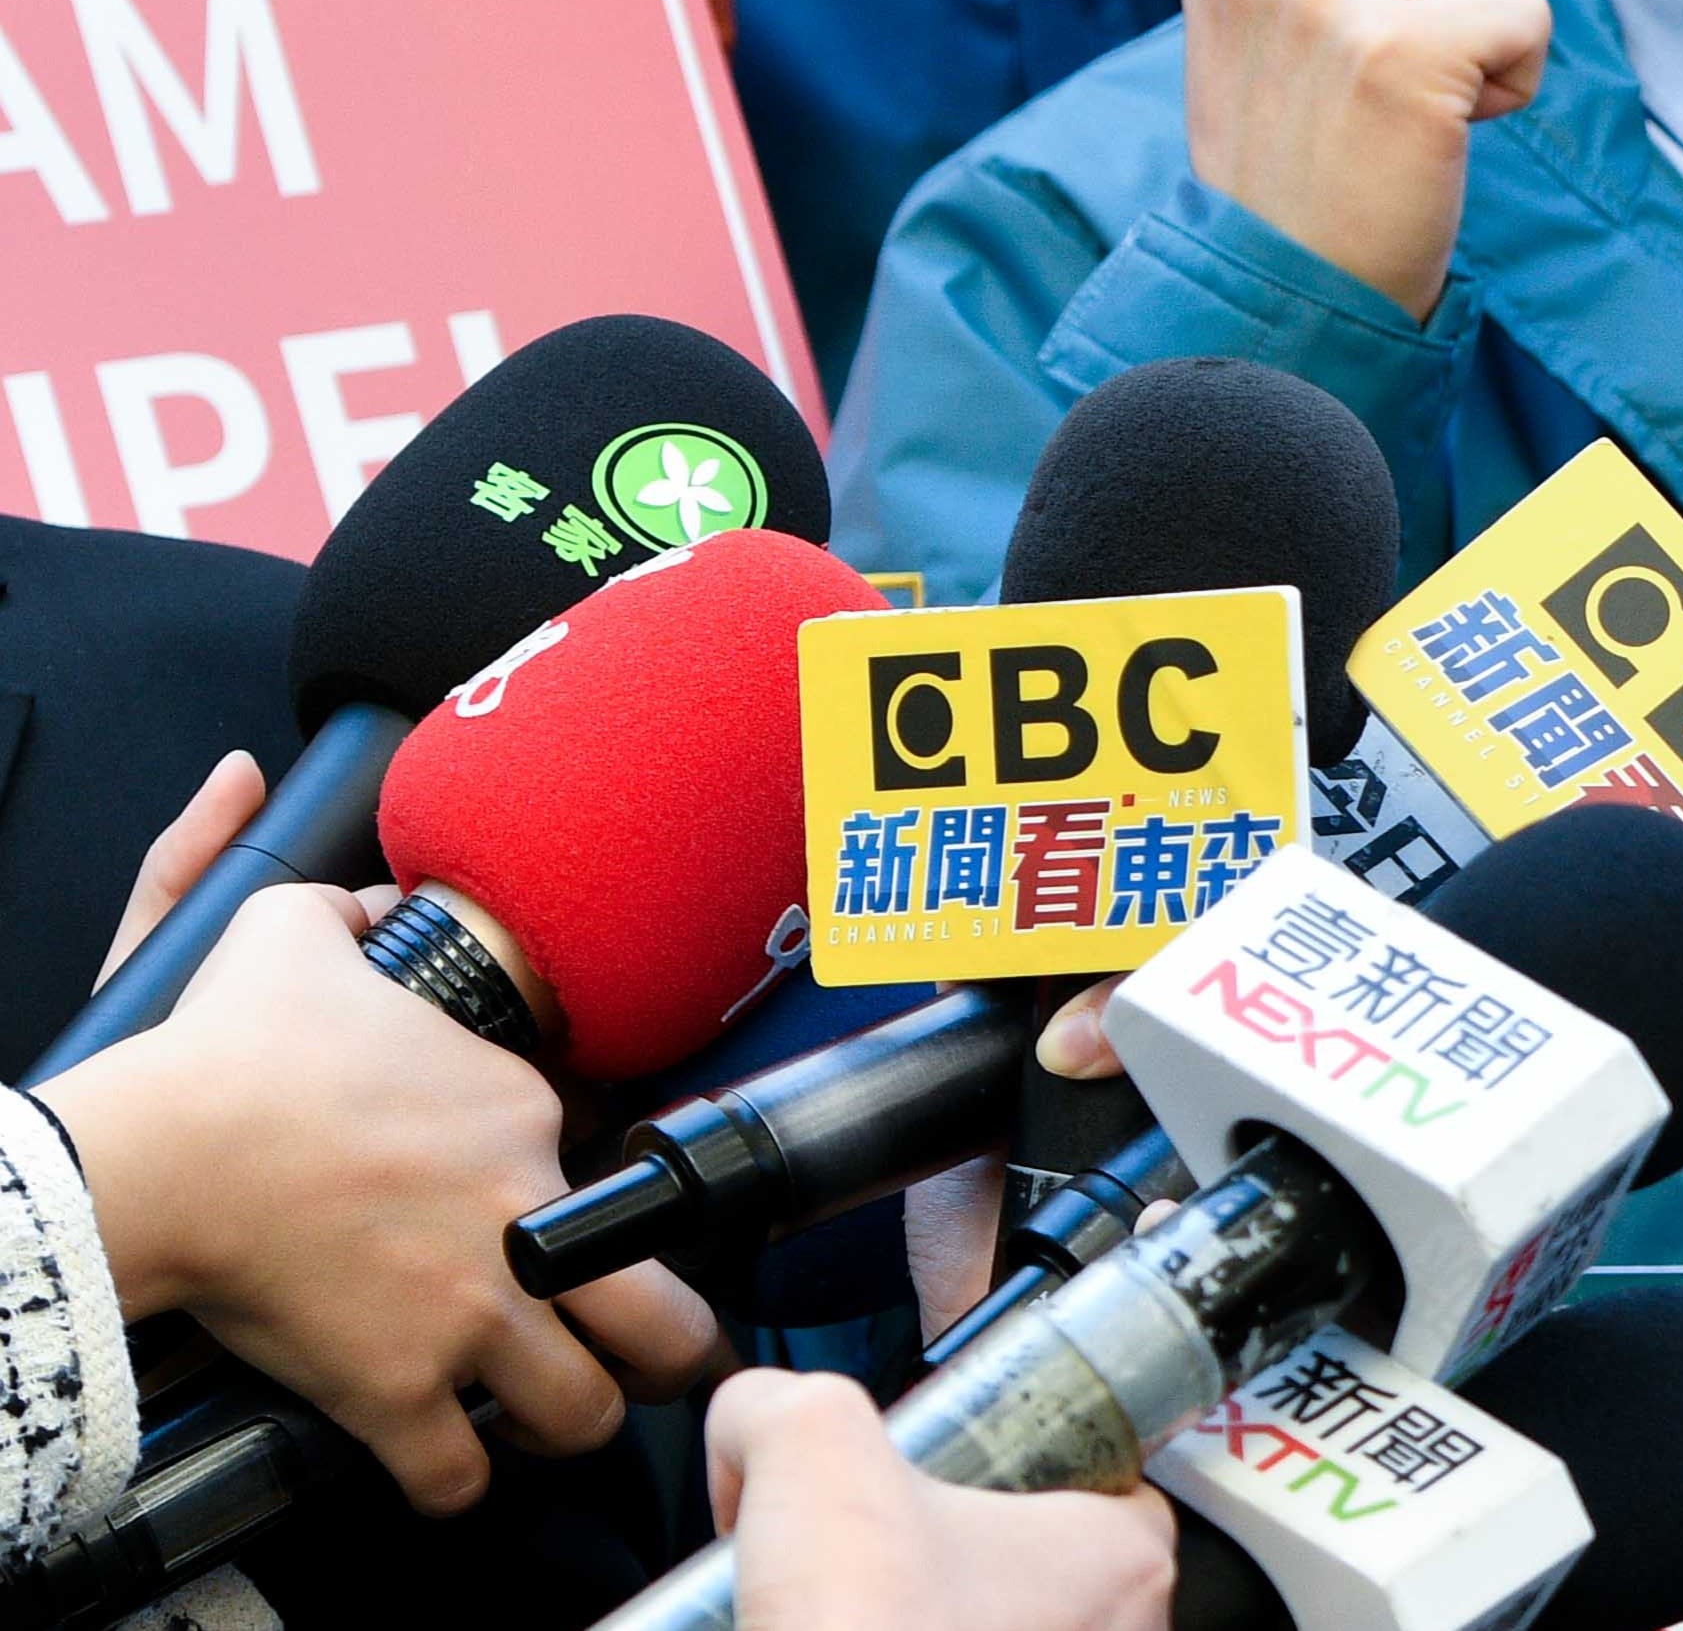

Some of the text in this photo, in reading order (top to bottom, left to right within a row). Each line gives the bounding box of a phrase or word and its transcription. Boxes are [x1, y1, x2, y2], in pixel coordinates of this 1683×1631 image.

[868, 637, 1222, 792] EBC
[1383, 639, 1540, 809] CHANNEL 51
[832, 800, 1284, 932] 新聞看東森
[1168, 787, 1229, 809] NEWS
[828, 917, 1001, 946] CHANNEL 51
[1242, 891, 1552, 1089] 壹新聞
[1253, 1350, 1485, 1493] 新聞
